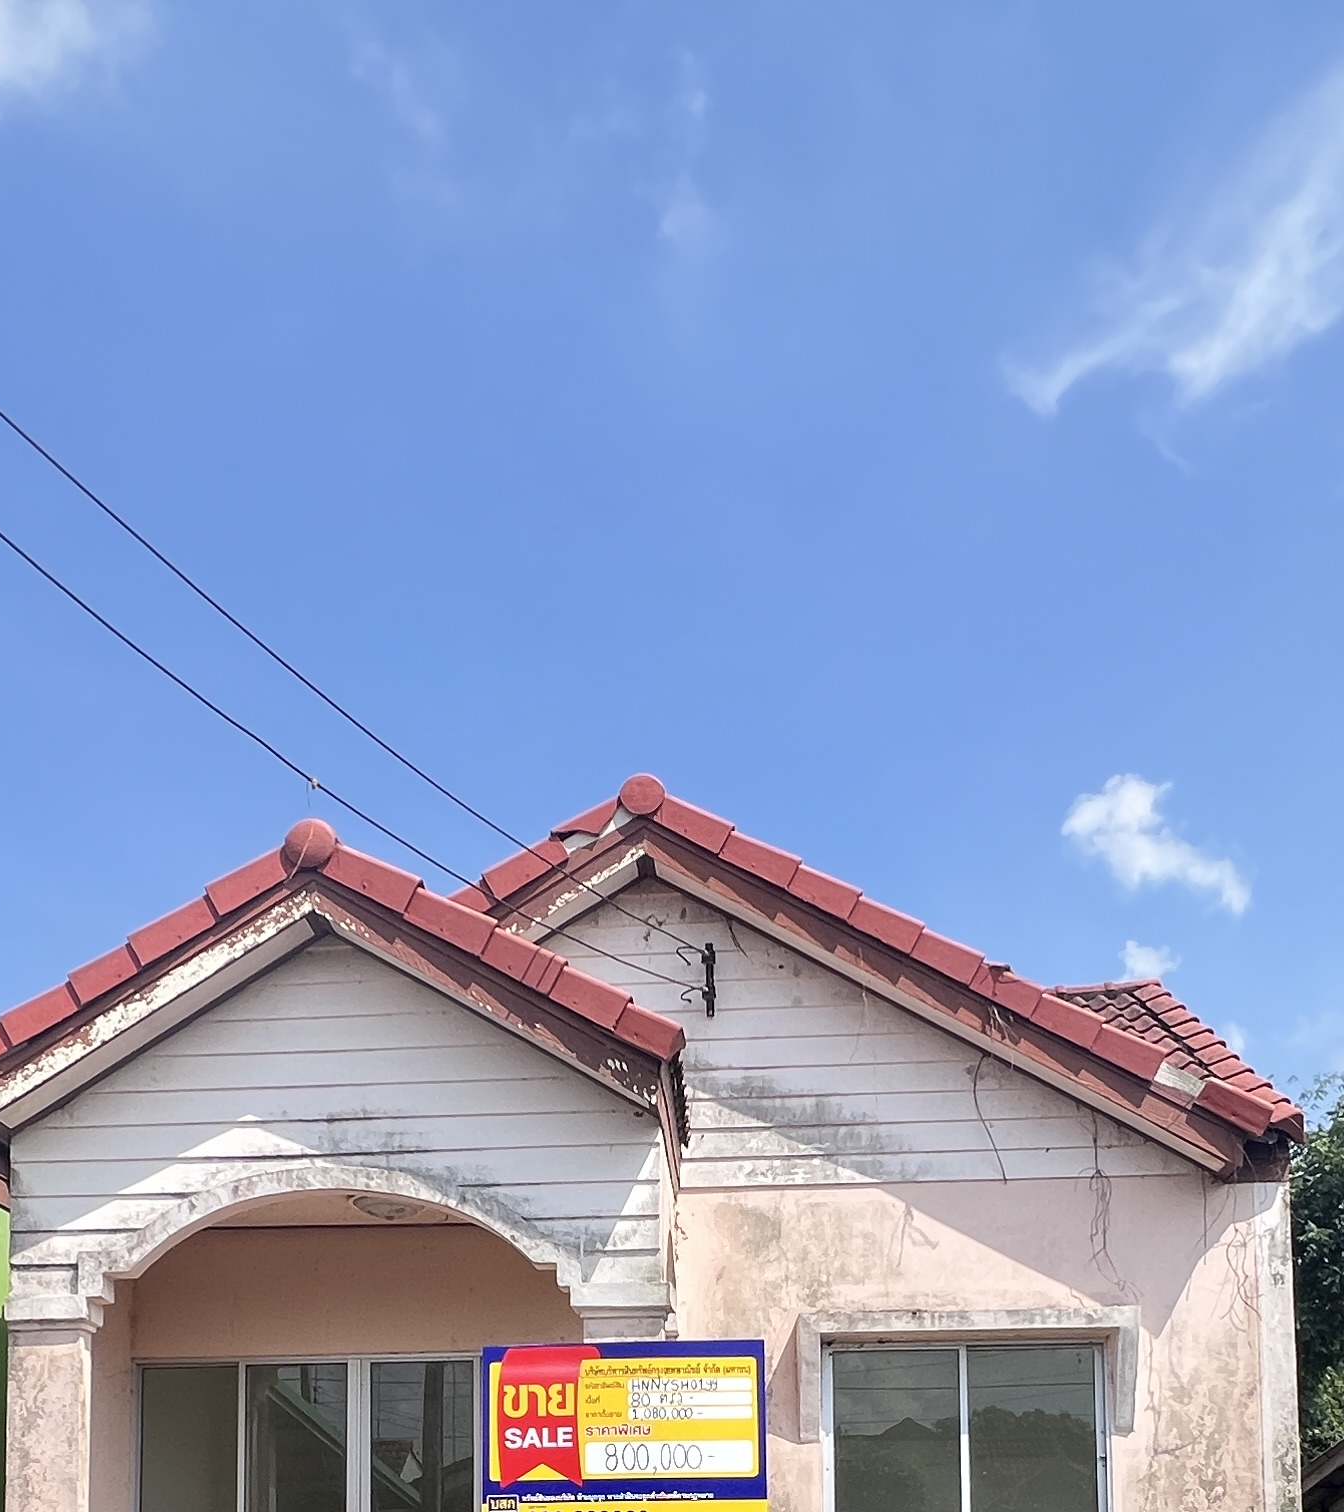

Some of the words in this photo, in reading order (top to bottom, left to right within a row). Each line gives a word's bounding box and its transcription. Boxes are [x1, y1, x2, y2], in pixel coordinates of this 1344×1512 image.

[503, 1382, 576, 1419] ขาย
[504, 1426, 574, 1449] SALE
[585, 1423, 651, 1437] ราคาพิเศษ
[490, 1498, 516, 1510] บสก
